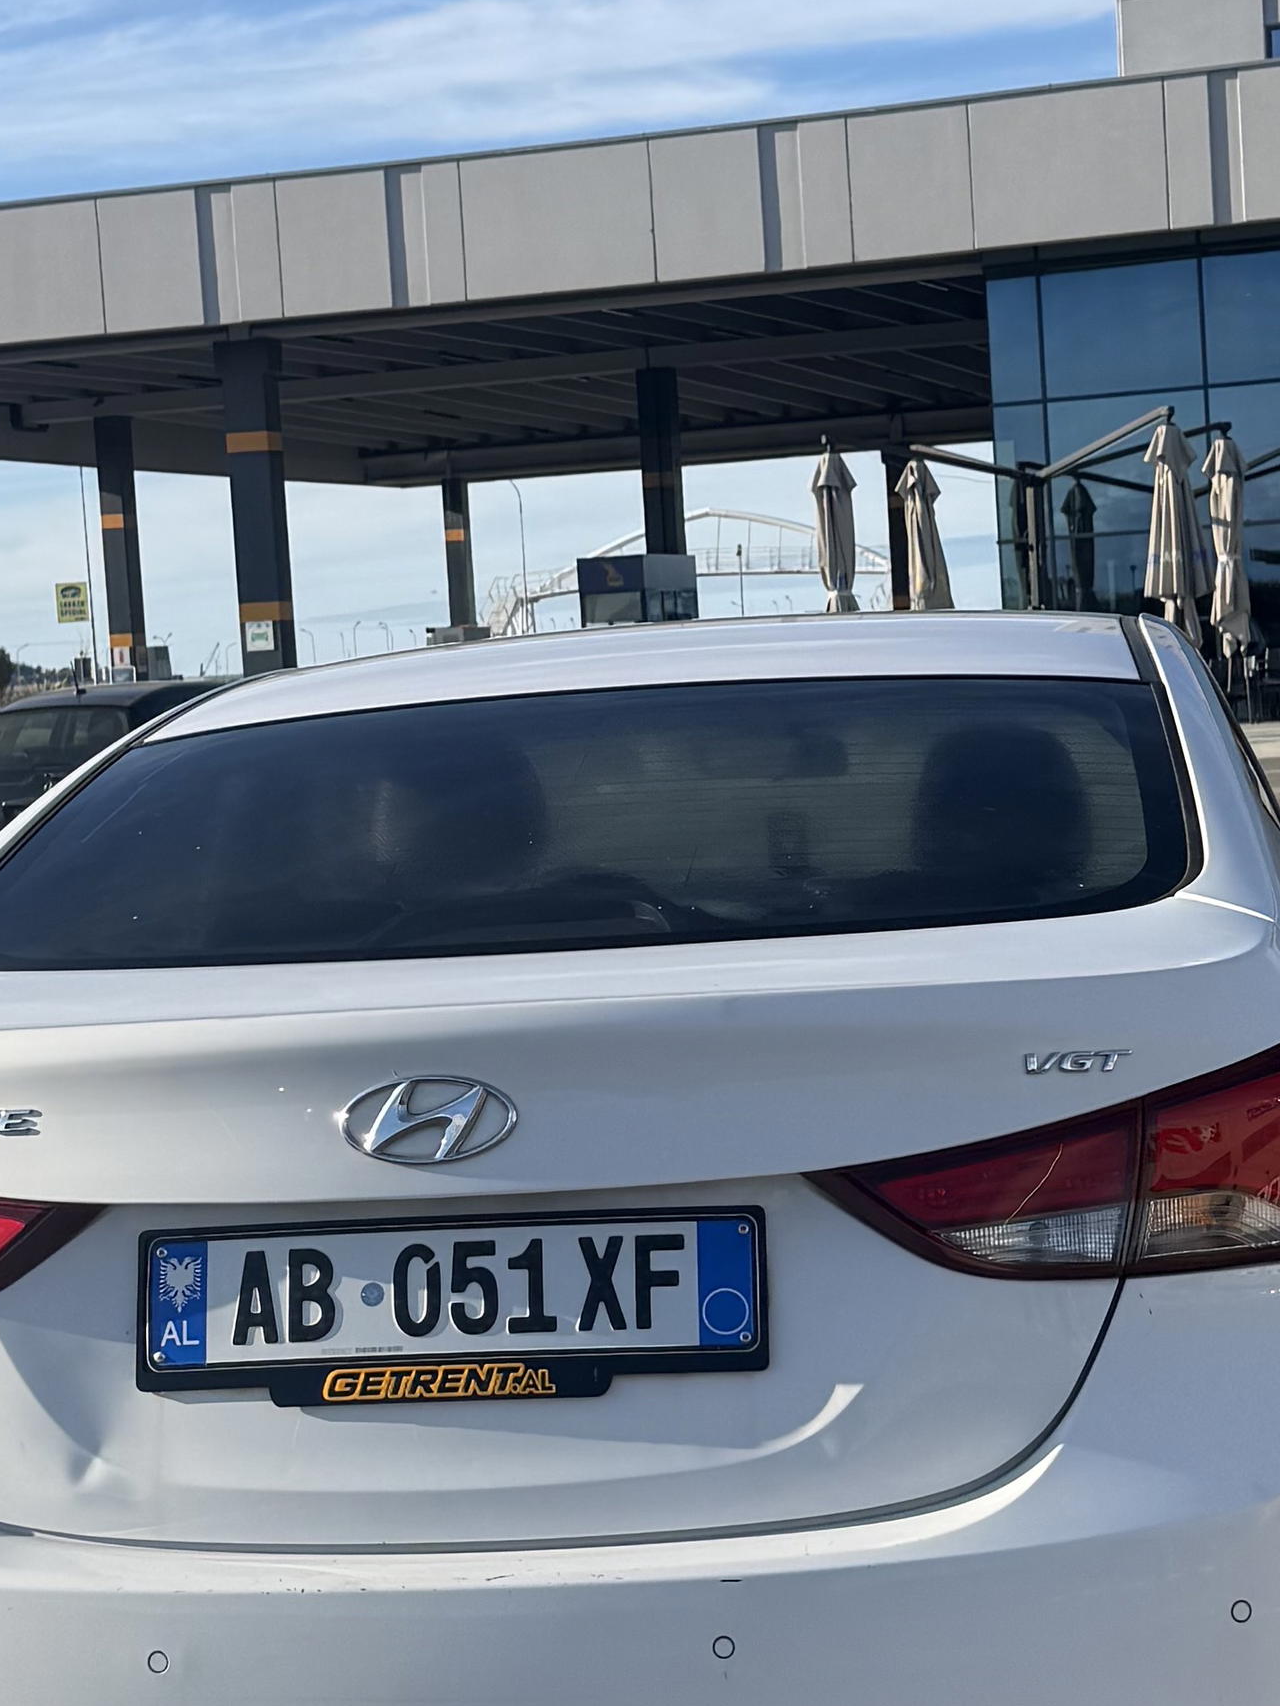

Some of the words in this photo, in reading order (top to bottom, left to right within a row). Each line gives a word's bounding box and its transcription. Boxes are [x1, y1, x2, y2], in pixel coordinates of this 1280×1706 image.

[1024, 1049, 1132, 1074] VGT
[231, 1248, 335, 1346] AB
[393, 1238, 557, 1338] 051
[577, 1234, 685, 1332] XF
[161, 1320, 200, 1347] AL
[322, 1362, 556, 1401] GETRENT.AL
